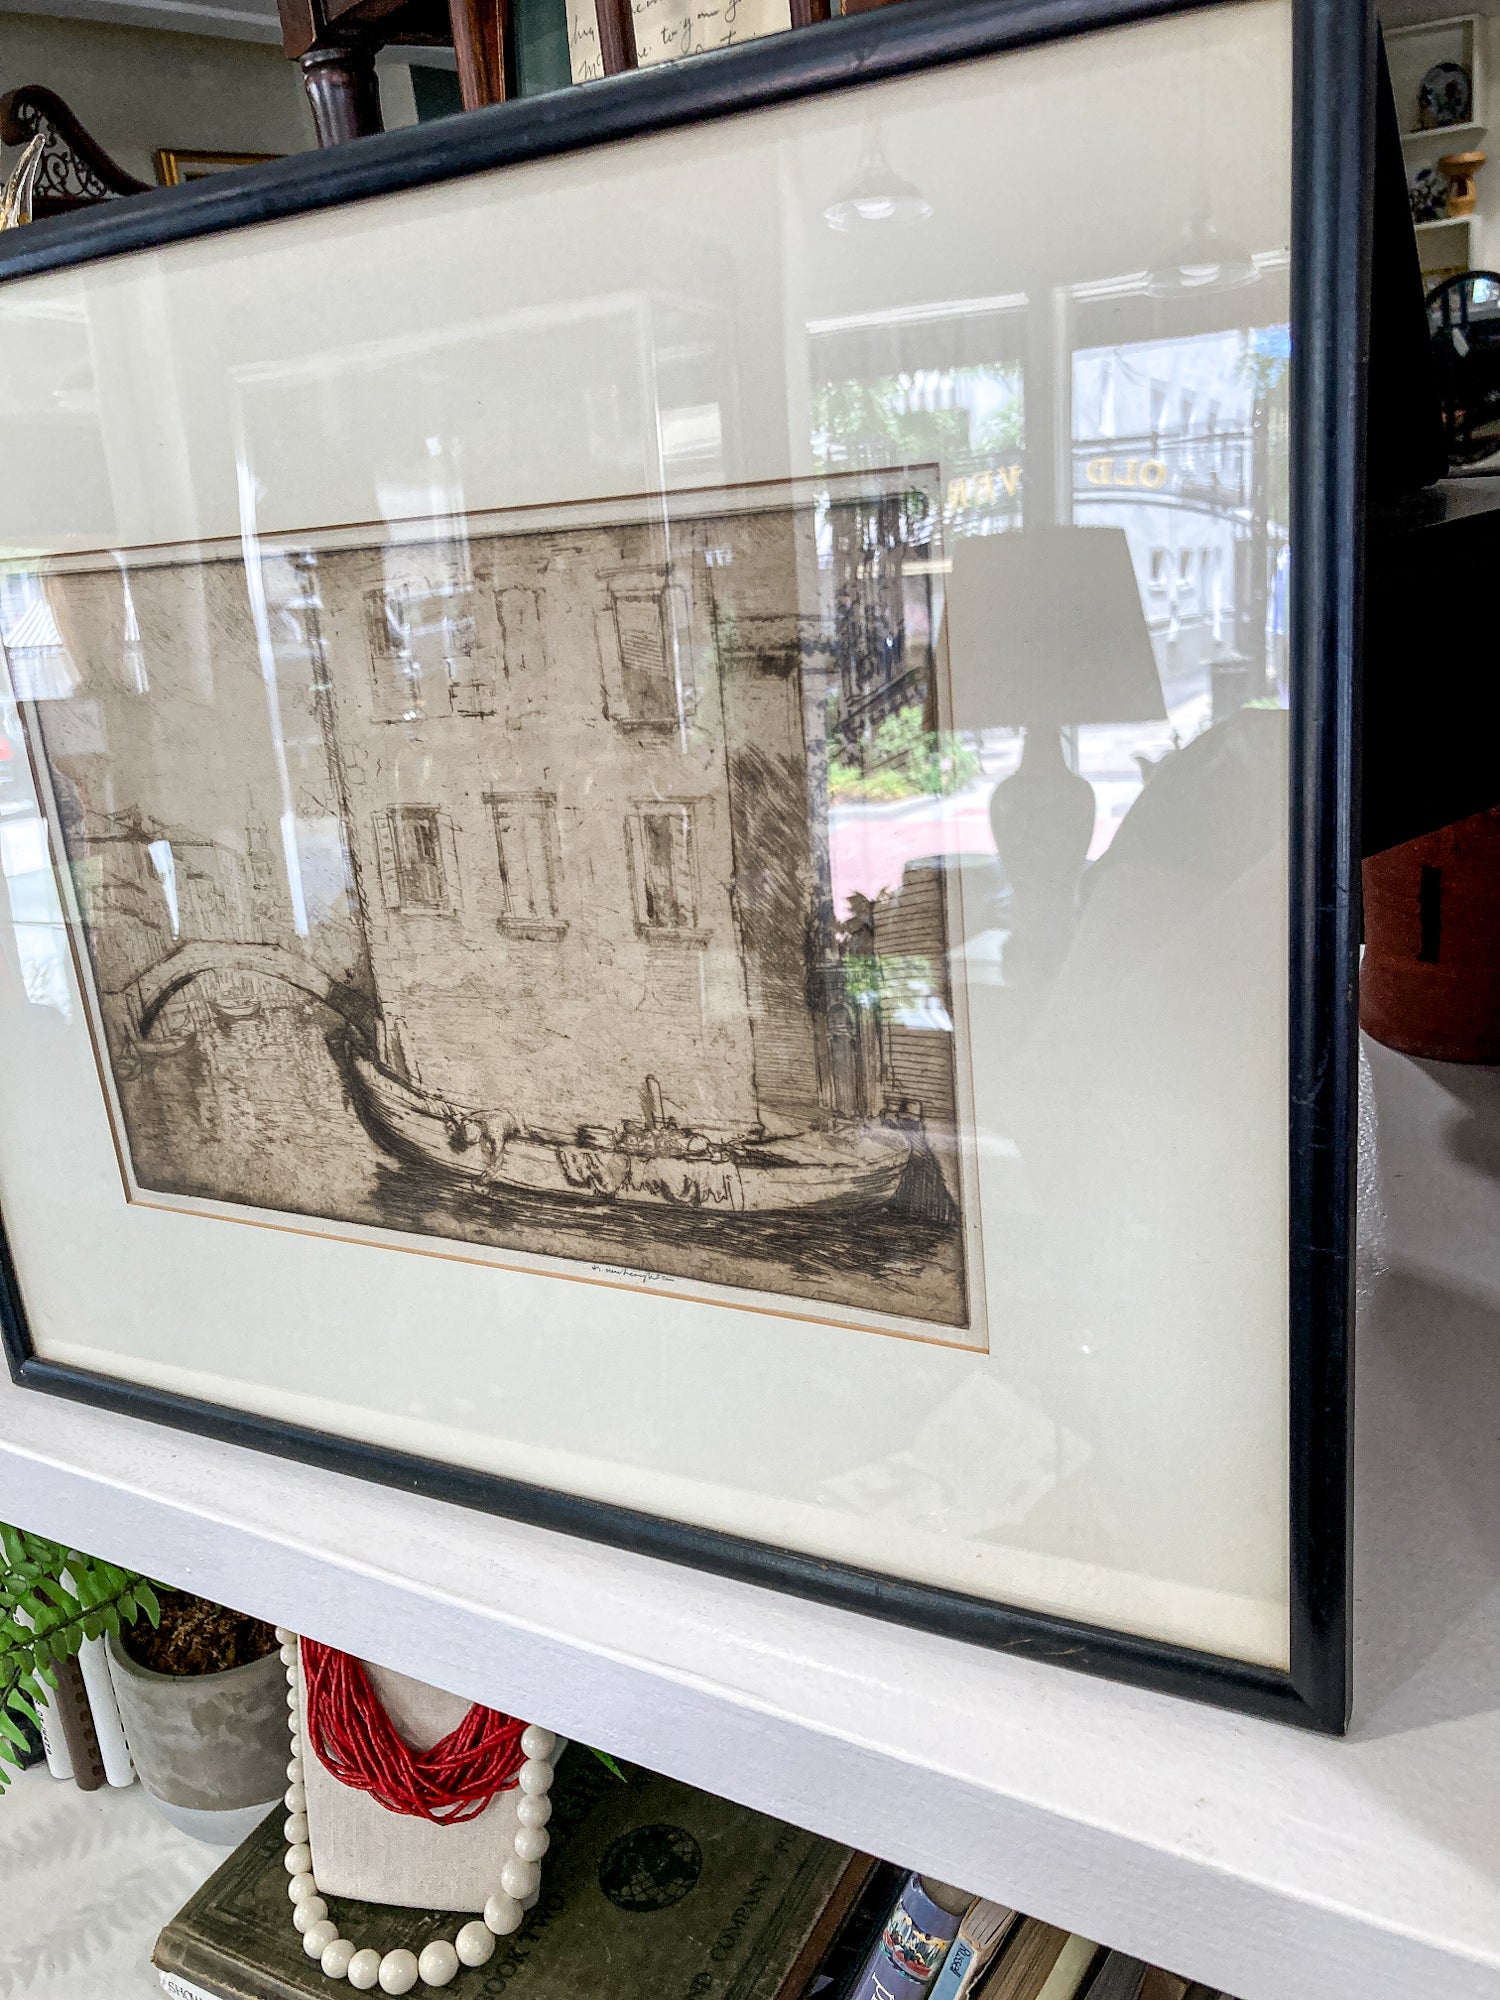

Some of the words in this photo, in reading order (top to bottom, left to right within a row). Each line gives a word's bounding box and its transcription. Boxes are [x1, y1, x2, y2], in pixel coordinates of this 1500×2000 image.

[517, 1892, 565, 1942] TWO
[710, 1870, 772, 1962] COMPANY
[949, 1942, 972, 1978] Russell
